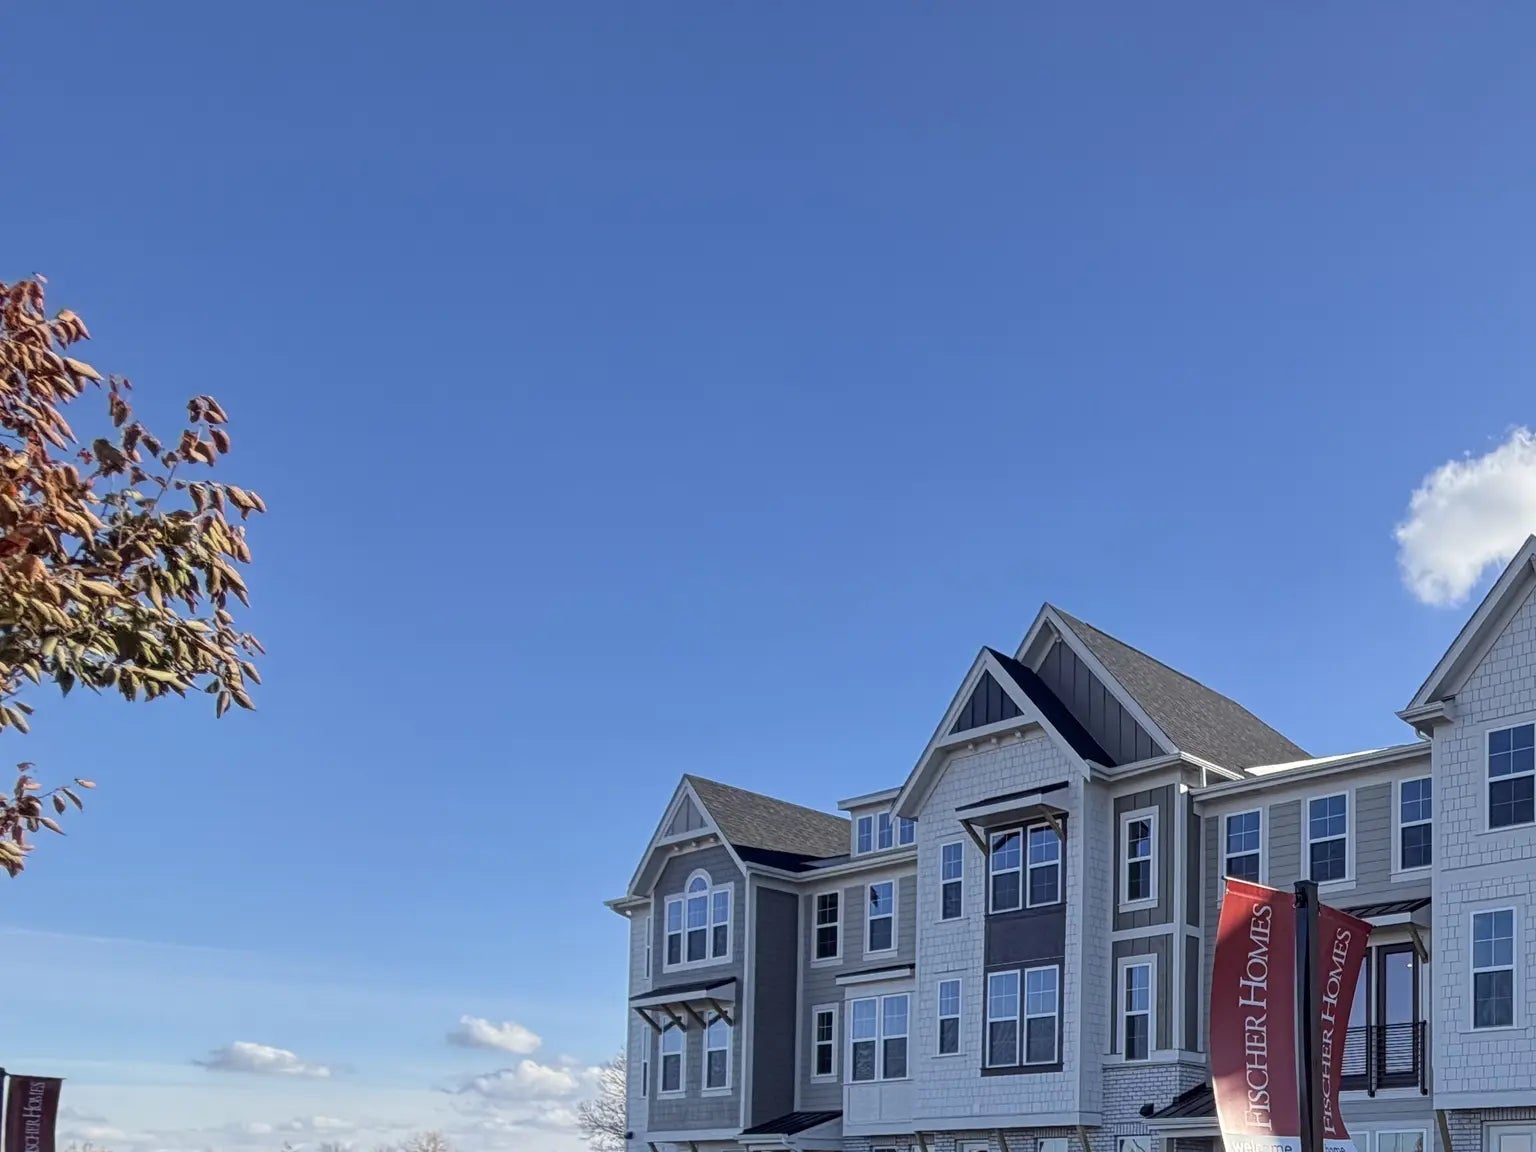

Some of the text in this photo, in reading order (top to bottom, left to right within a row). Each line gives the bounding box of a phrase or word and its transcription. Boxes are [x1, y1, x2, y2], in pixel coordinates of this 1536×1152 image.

[1239, 903, 1273, 1132] FISCHER HOMES
[1320, 927, 1351, 1136] FISCHER HOMES
